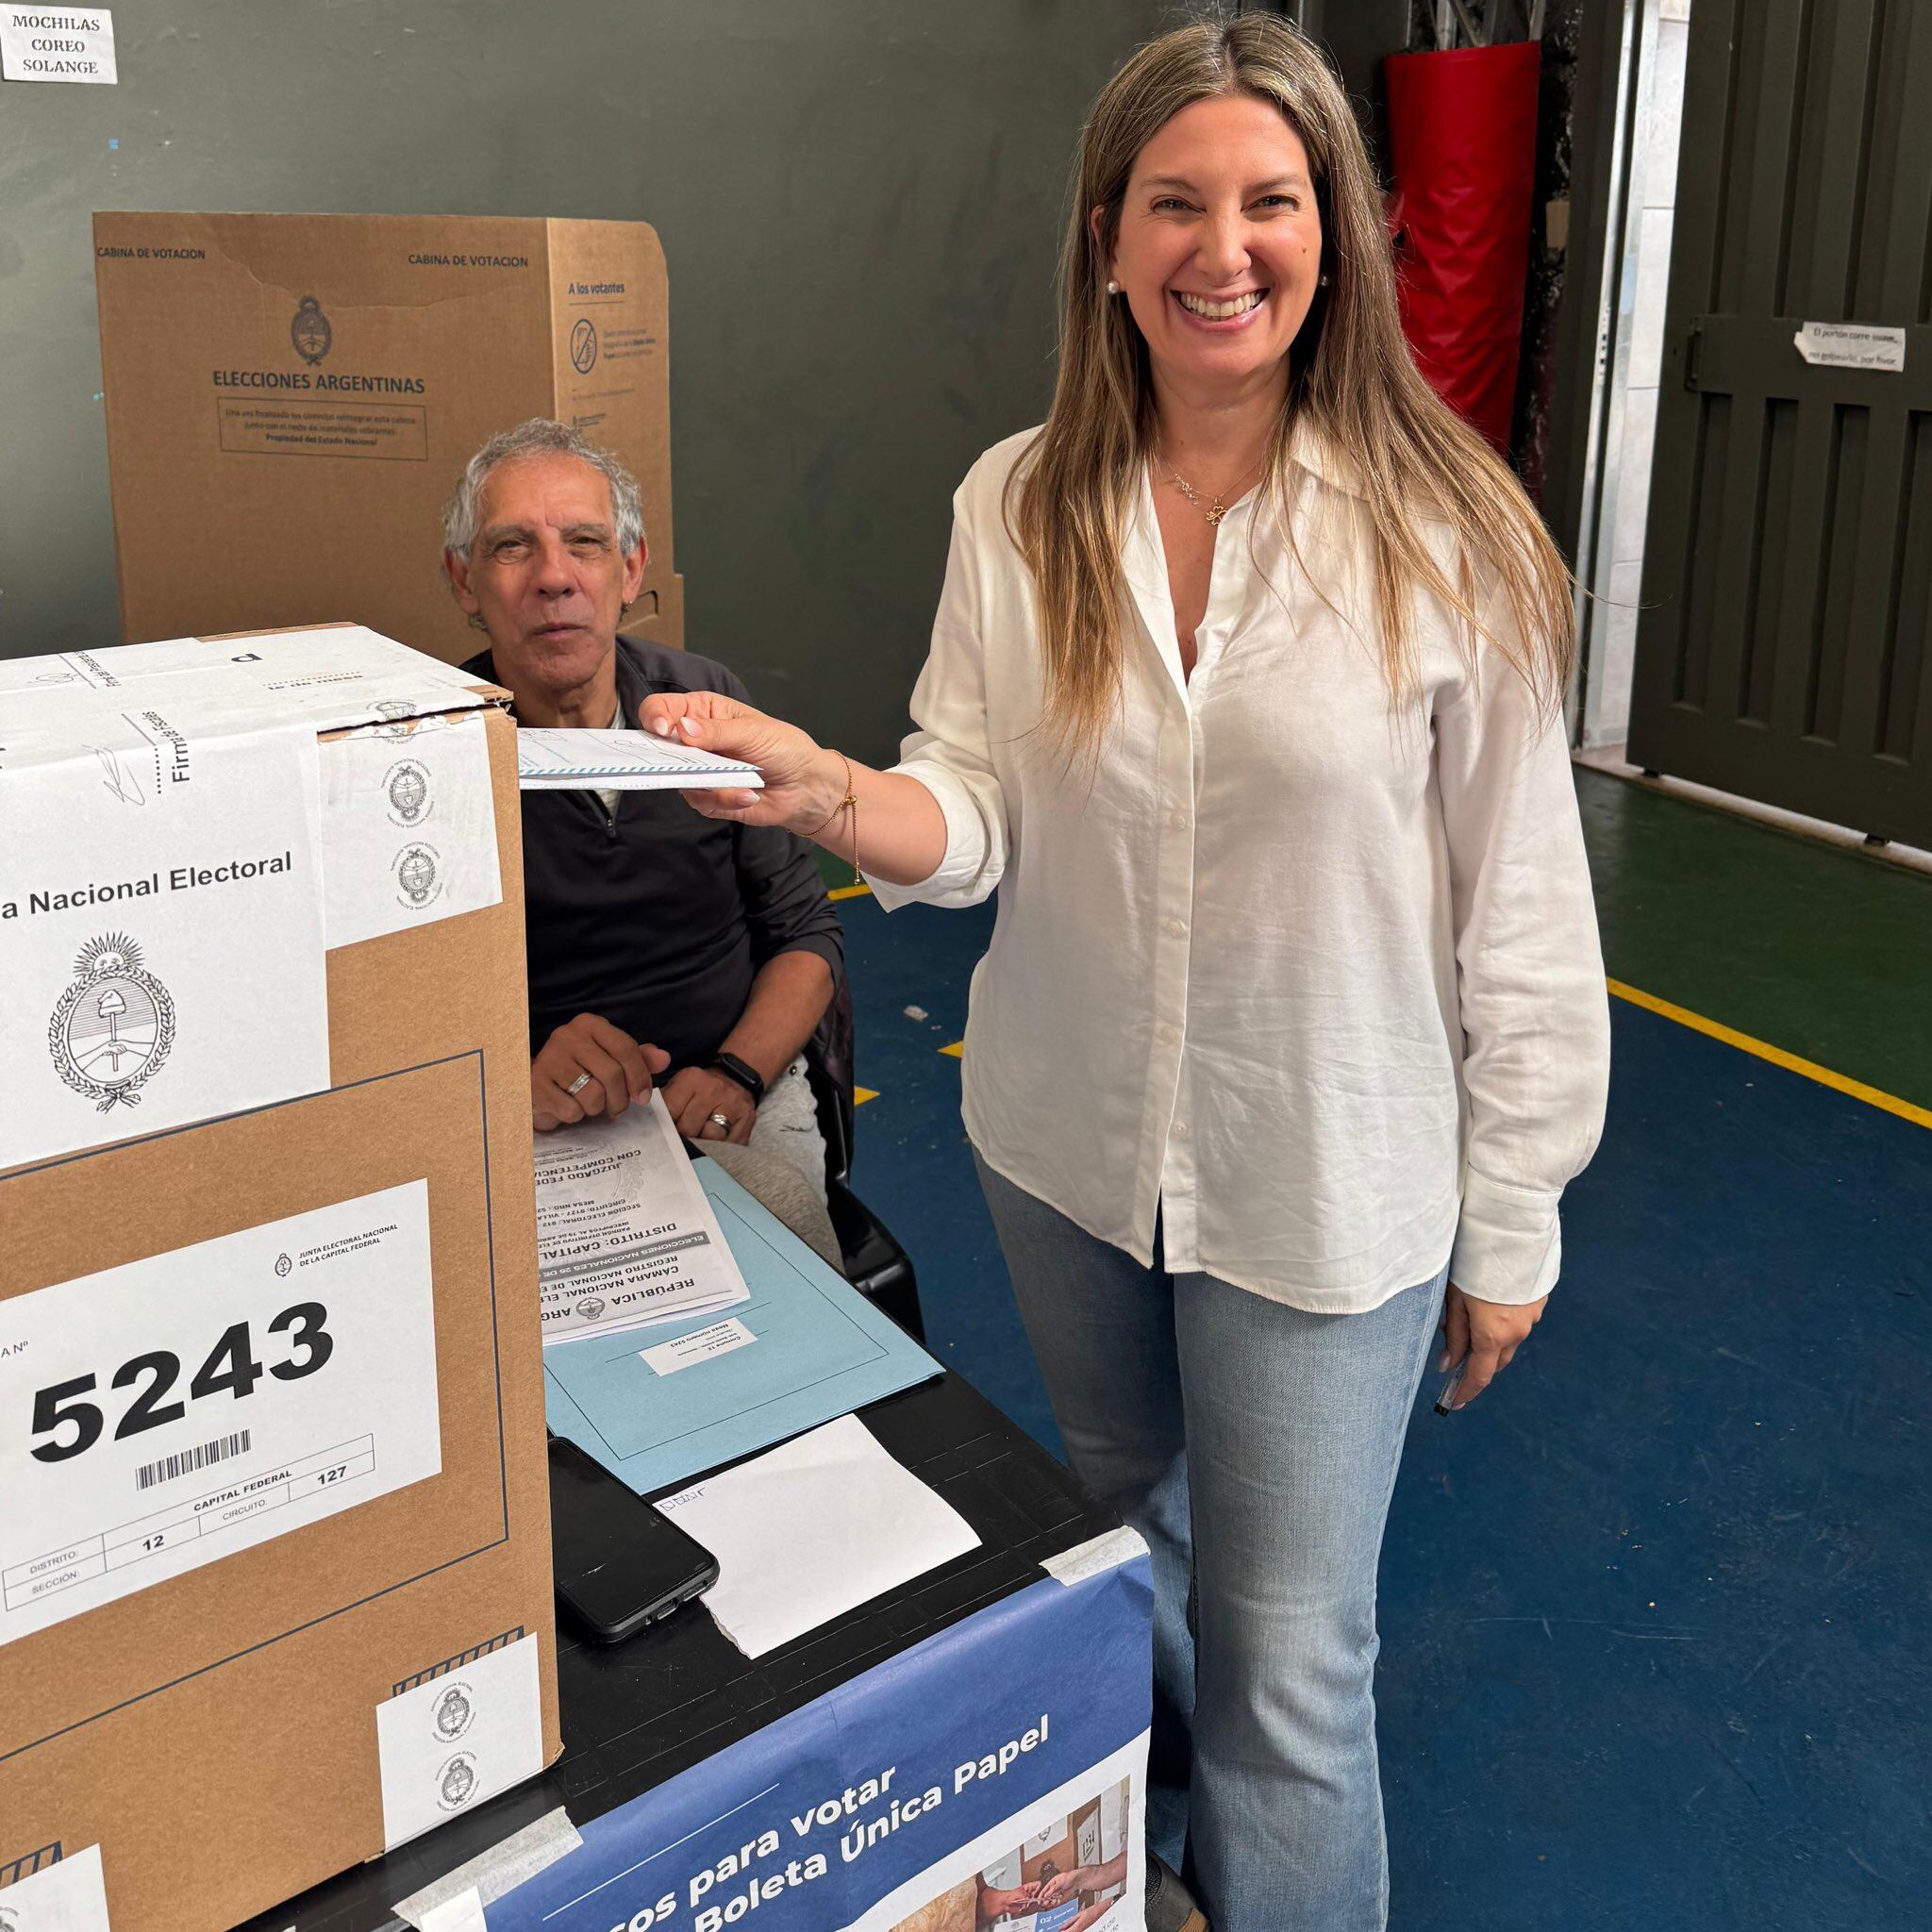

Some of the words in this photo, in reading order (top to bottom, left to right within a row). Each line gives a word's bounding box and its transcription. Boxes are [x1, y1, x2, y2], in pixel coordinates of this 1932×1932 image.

[12, 14, 101, 32] MOCHILAS
[31, 39, 86, 53] COREO
[23, 58, 99, 75] SOLANGE
[97, 247, 135, 258] CABINA
[138, 248, 150, 258] DE
[153, 249, 206, 260] VOTACION
[408, 254, 449, 265] CABINA
[453, 256, 467, 266] DE
[470, 256, 528, 268] VOTACION
[569, 283, 575, 294] A
[576, 282, 590, 294] los
[591, 282, 625, 294] votantes
[1849, 331, 1871, 341] corre
[213, 370, 310, 391] ELECCIONES
[315, 374, 425, 394] ARGENTINAS
[171, 736, 191, 783] Firma
[30, 873, 158, 914] Nacional
[170, 851, 291, 891] Electoral
[617, 1149, 641, 1160] CON
[568, 1161, 623, 1180] JUZGADO
[572, 1199, 595, 1208] MESA
[587, 1198, 626, 1211] CIRCUITO:
[608, 1203, 641, 1216] SECCIÓN
[589, 1221, 629, 1233] INSCRIPTOS
[605, 1223, 677, 1245] DISTRITO:
[299, 1247, 322, 1259] JUNTA
[323, 1235, 362, 1252] ELECTORAL
[362, 1224, 398, 1240] NACIONAL
[539, 1241, 601, 1259] CAPITAL
[641, 1235, 705, 1255] ELECCIONES
[299, 1258, 309, 1267] DE
[321, 1247, 350, 1260] CAPITAL
[350, 1238, 381, 1252] FEDERAL
[574, 1252, 639, 1271] NACIONALES
[625, 1255, 678, 1274] REGISTRO
[568, 1270, 623, 1286] NACIONAL
[627, 1265, 679, 1284] CÁMARA
[551, 1282, 565, 1291] DE
[563, 1279, 625, 1297] NACIONAL
[611, 1278, 695, 1305] REPÚBLICA
[711, 1324, 729, 1332] Mesa
[1, 1347, 10, 1358] A
[30, 1301, 334, 1463] 5243
[29, 1550, 79, 1574] DISTRITO:
[193, 1490, 241, 1511] CAPITAL
[243, 1470, 292, 1493] FEDERAL
[32, 1570, 81, 1594] SECCIÓN:
[142, 1535, 165, 1552] 12
[317, 1465, 347, 1486] 127
[694, 1853, 827, 1932] Boleta
[841, 1786, 942, 1863] Única
[954, 1713, 1049, 1795] Papel
[689, 1829, 779, 1908] para
[791, 1766, 896, 1837] votar
